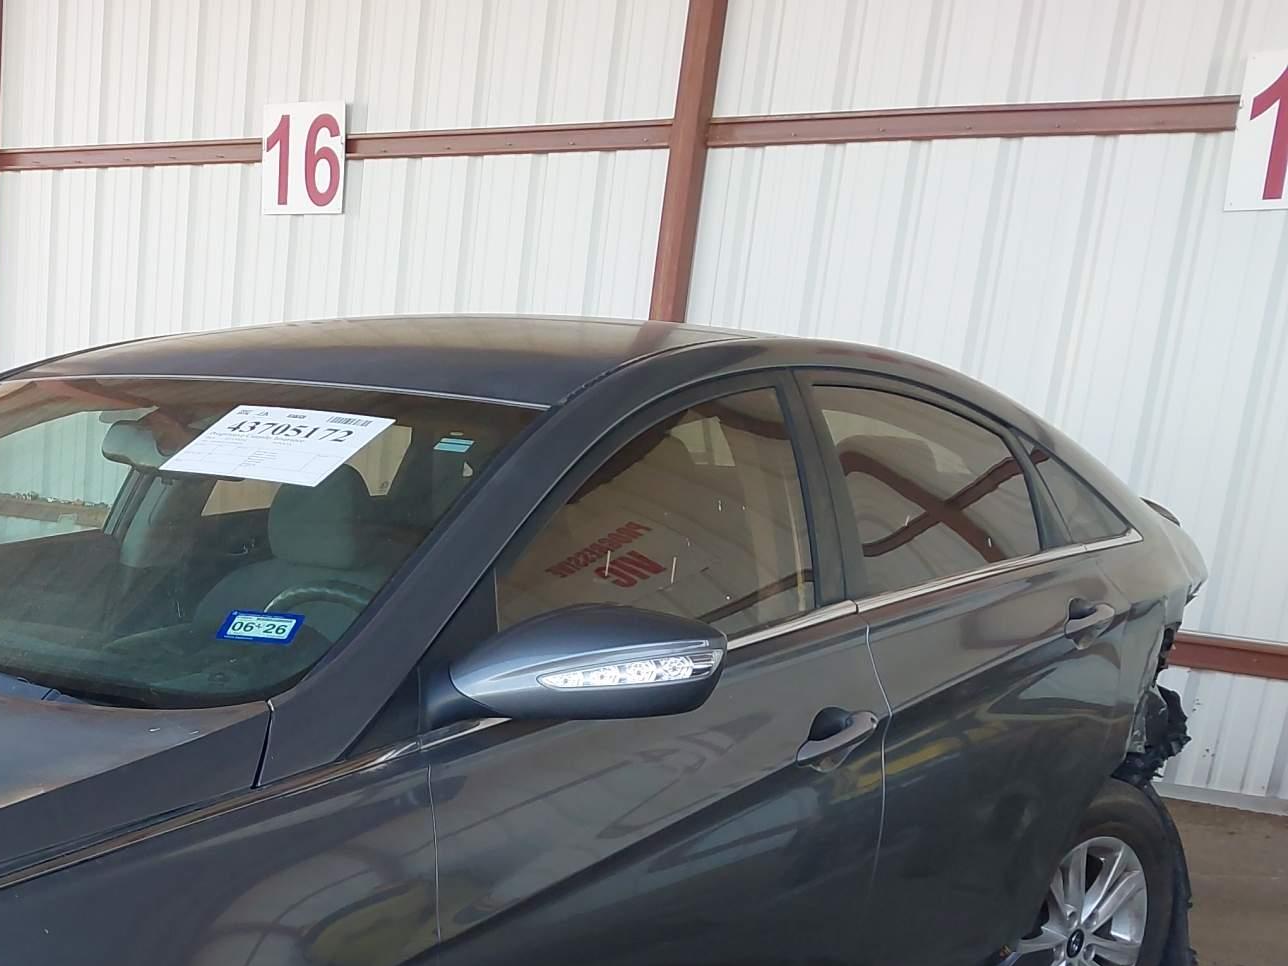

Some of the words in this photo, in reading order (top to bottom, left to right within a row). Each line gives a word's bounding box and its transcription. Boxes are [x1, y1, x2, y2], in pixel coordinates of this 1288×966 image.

[266, 113, 341, 207] 16
[227, 420, 355, 443] 43705172
[231, 620, 256, 632] 06
[262, 623, 289, 635] 26
